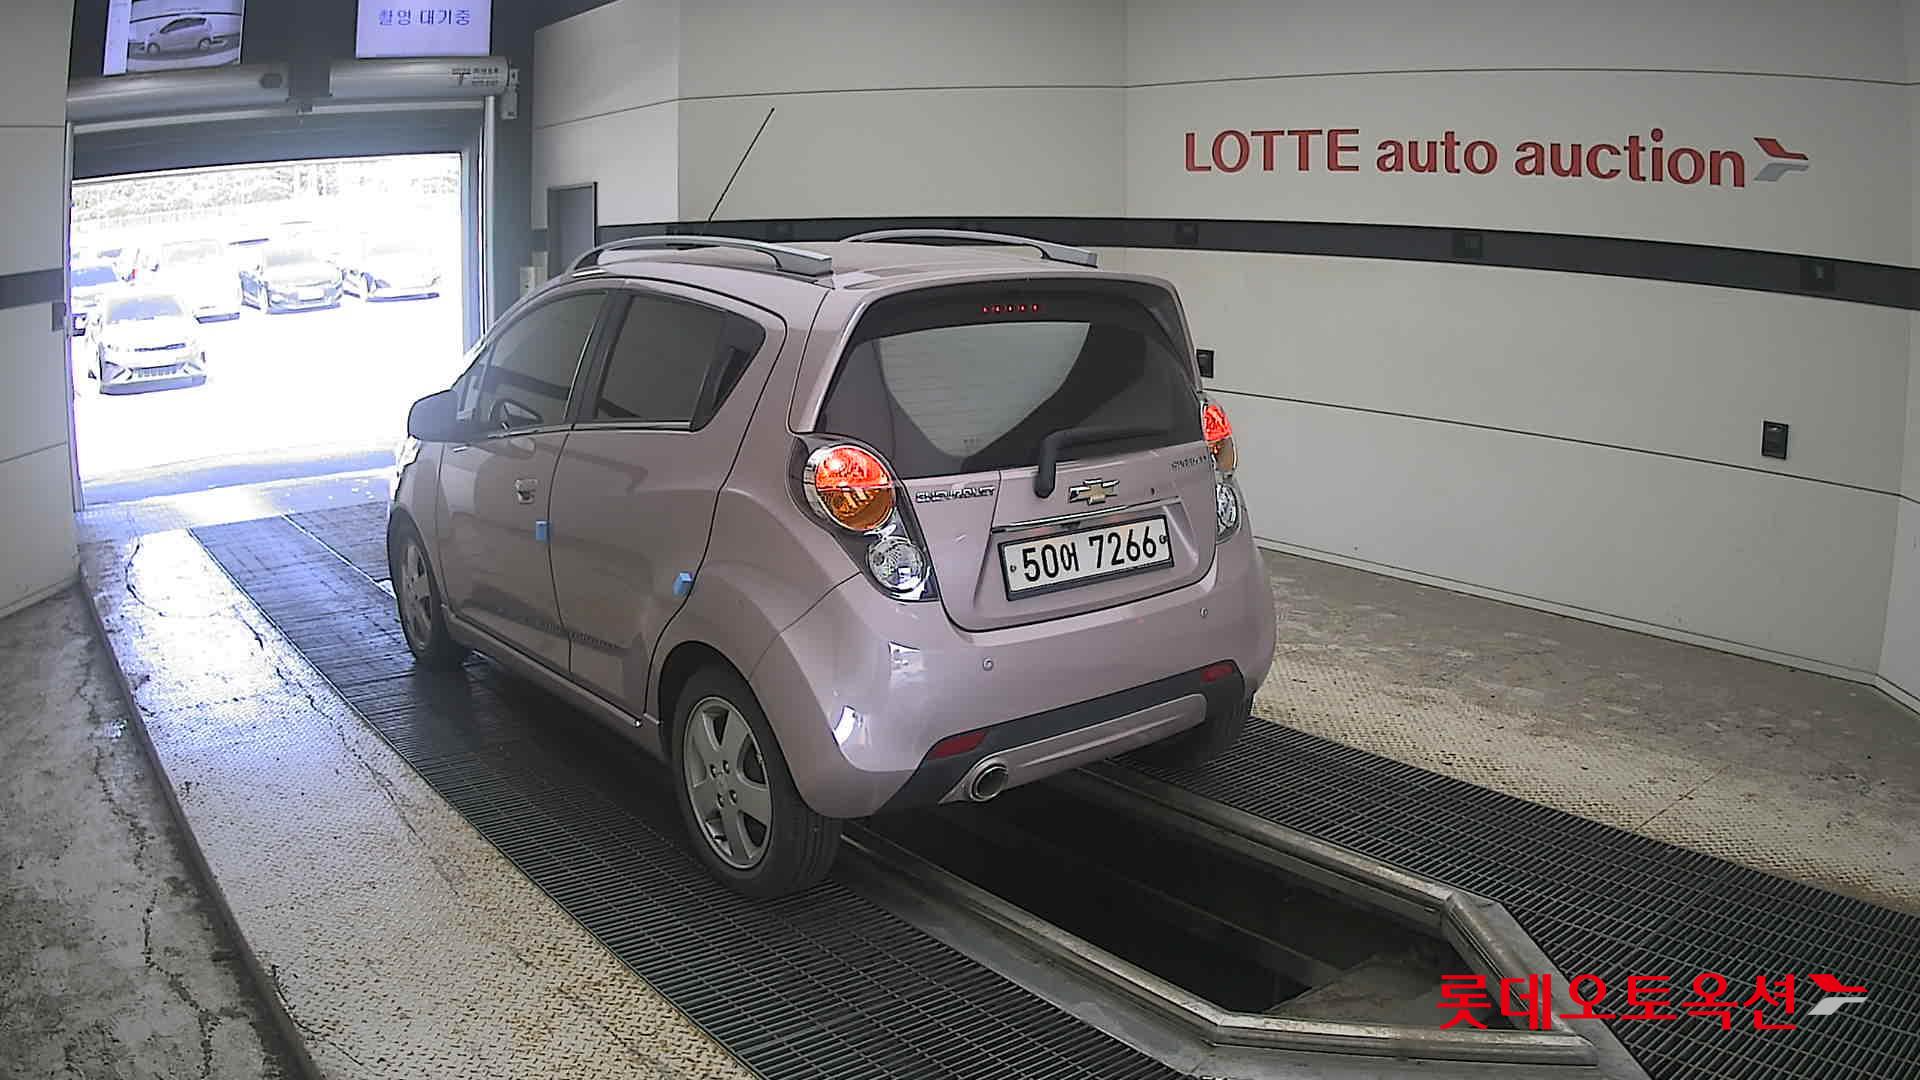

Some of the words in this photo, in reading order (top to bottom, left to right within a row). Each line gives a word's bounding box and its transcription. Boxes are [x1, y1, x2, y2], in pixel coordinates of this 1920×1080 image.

[420, 9, 470, 26] 대기중
[1184, 128, 1360, 173] LOTTE
[1376, 132, 1499, 174] auto
[1514, 129, 1745, 188] auction
[1021, 541, 1080, 582] 50어
[1087, 525, 1158, 569] 7266
